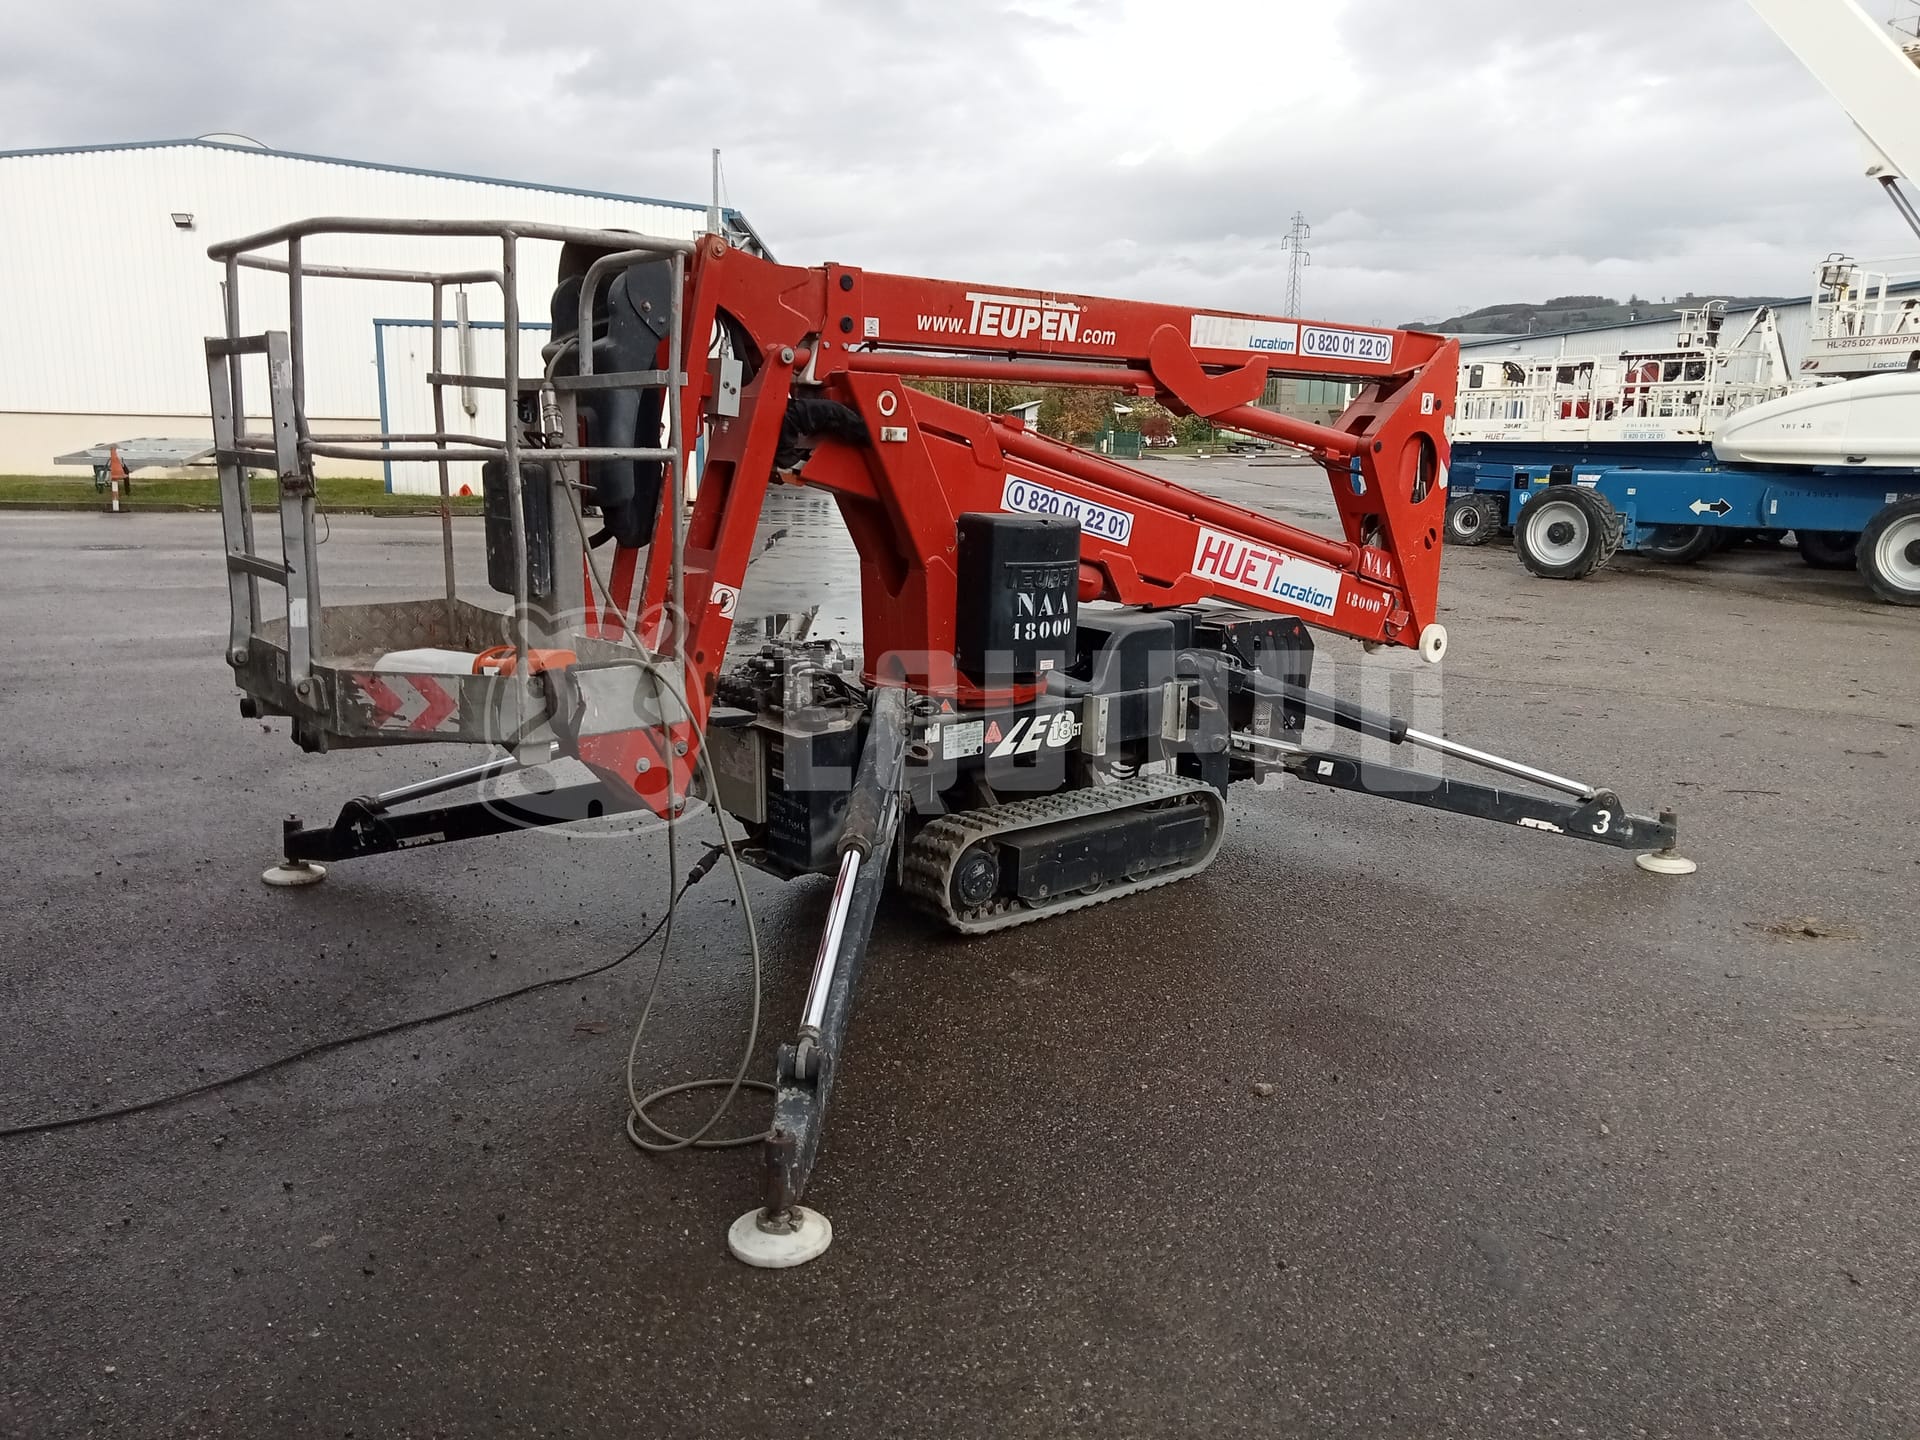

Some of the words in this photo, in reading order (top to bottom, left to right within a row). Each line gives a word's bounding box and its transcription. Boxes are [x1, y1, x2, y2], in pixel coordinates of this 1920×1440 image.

[1249, 335, 1294, 351] Location
[1307, 333, 1315, 350] 0
[1318, 334, 1340, 351] 820
[1342, 336, 1355, 354] 01
[1359, 338, 1373, 356] 22
[1376, 340, 1387, 357] 01
[1827, 341, 1857, 349] HL-275
[1859, 339, 1876, 347] D27
[1872, 361, 1907, 369] Locatio
[1014, 485, 1025, 506] 0
[1028, 490, 1059, 515] 820
[1084, 508, 1105, 531] 22
[1108, 515, 1125, 537] 01
[1197, 536, 1284, 591] HUET
[1272, 576, 1333, 609] Location
[1362, 551, 1392, 578] NAA
[1016, 591, 1069, 617] NAA
[1345, 591, 1380, 613] 18000
[1013, 617, 1071, 640] 18000
[989, 710, 1075, 758] LEO
[1592, 810, 1611, 834] 3
